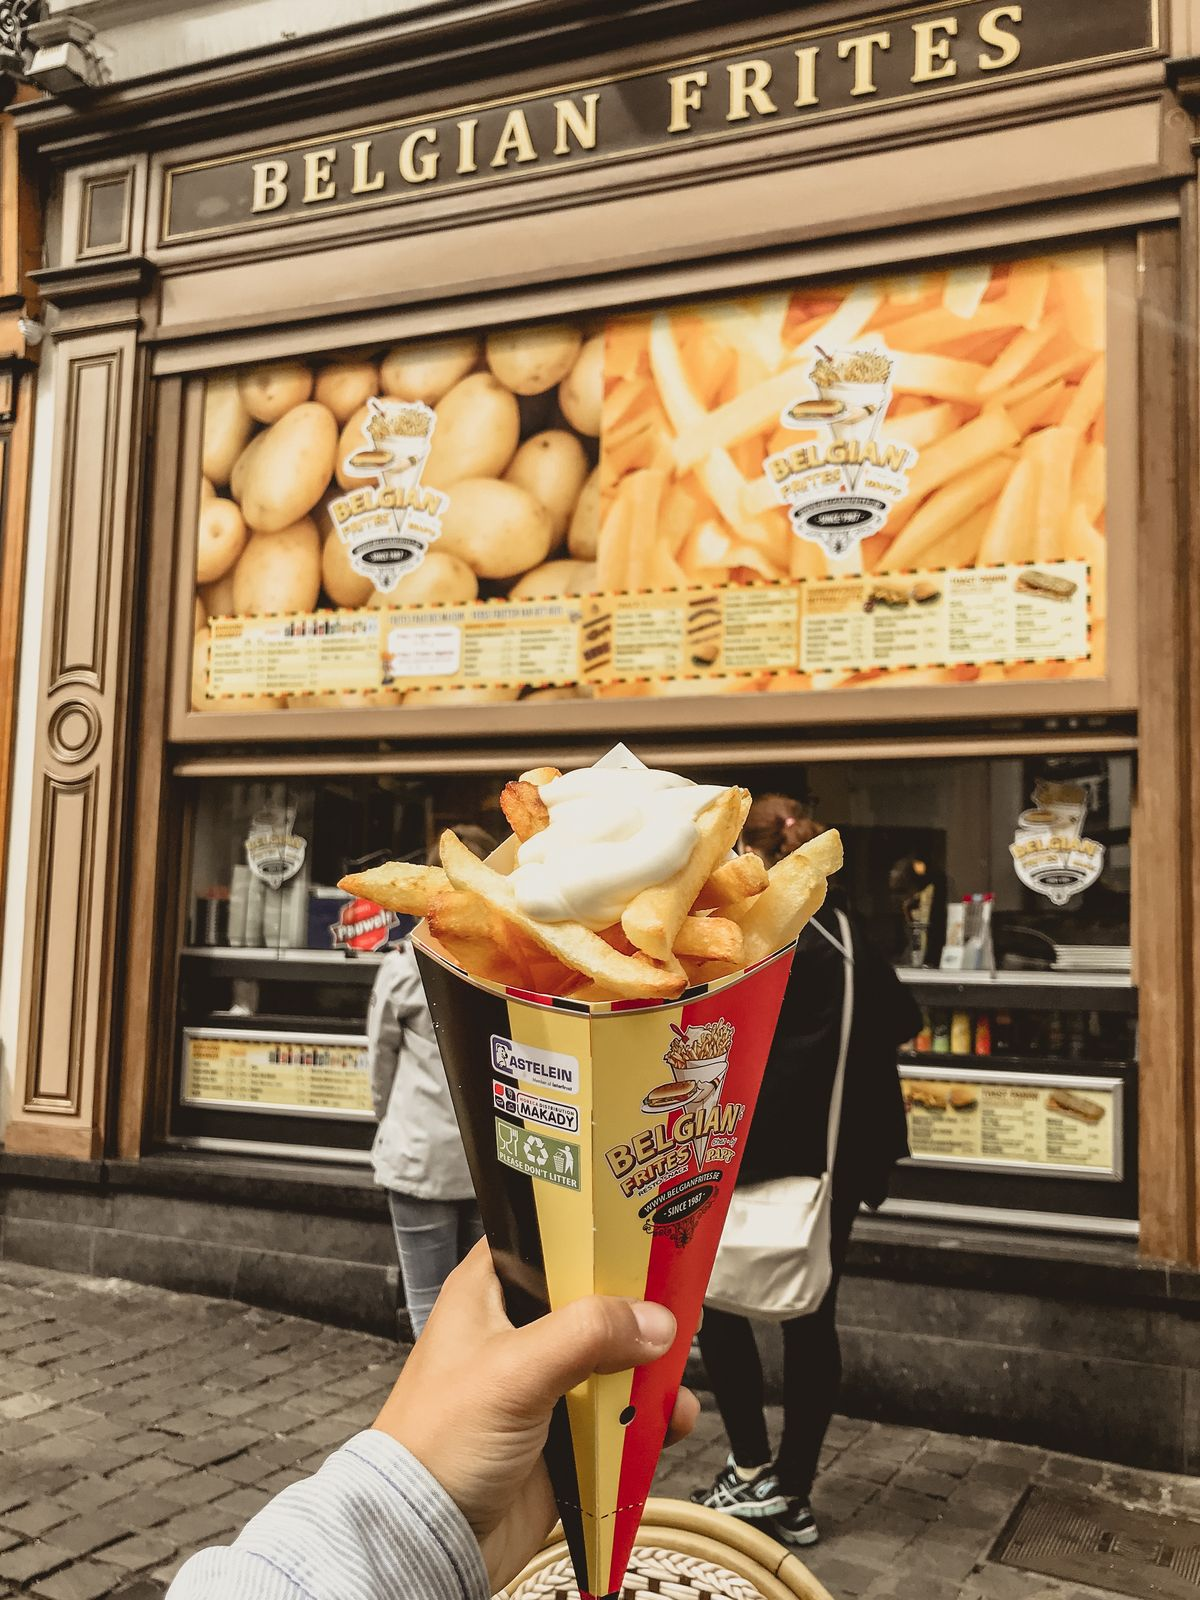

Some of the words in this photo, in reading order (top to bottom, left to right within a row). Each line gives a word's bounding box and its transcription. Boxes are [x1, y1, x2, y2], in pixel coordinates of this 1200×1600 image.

[251, 93, 600, 213] BELGIAN
[667, 5, 1022, 133] FRITES
[769, 441, 908, 482] BELGIAN
[335, 488, 440, 521] BELGIAN
[1013, 835, 1098, 859] BELGIAN
[521, 1103, 575, 1127] MAKADY
[539, 1101, 575, 1116] DISTRIBUTION
[604, 1103, 739, 1179] BELGIAN
[499, 1151, 524, 1170] PLEASE
[524, 1163, 548, 1179] DON'T
[549, 1171, 578, 1188] LITTER
[619, 1143, 693, 1199] FRITES
[643, 1171, 721, 1214] WWW.BELGIANFRITES.BE
[667, 1200, 687, 1218] SINCE
[687, 1192, 703, 1209] 1987
